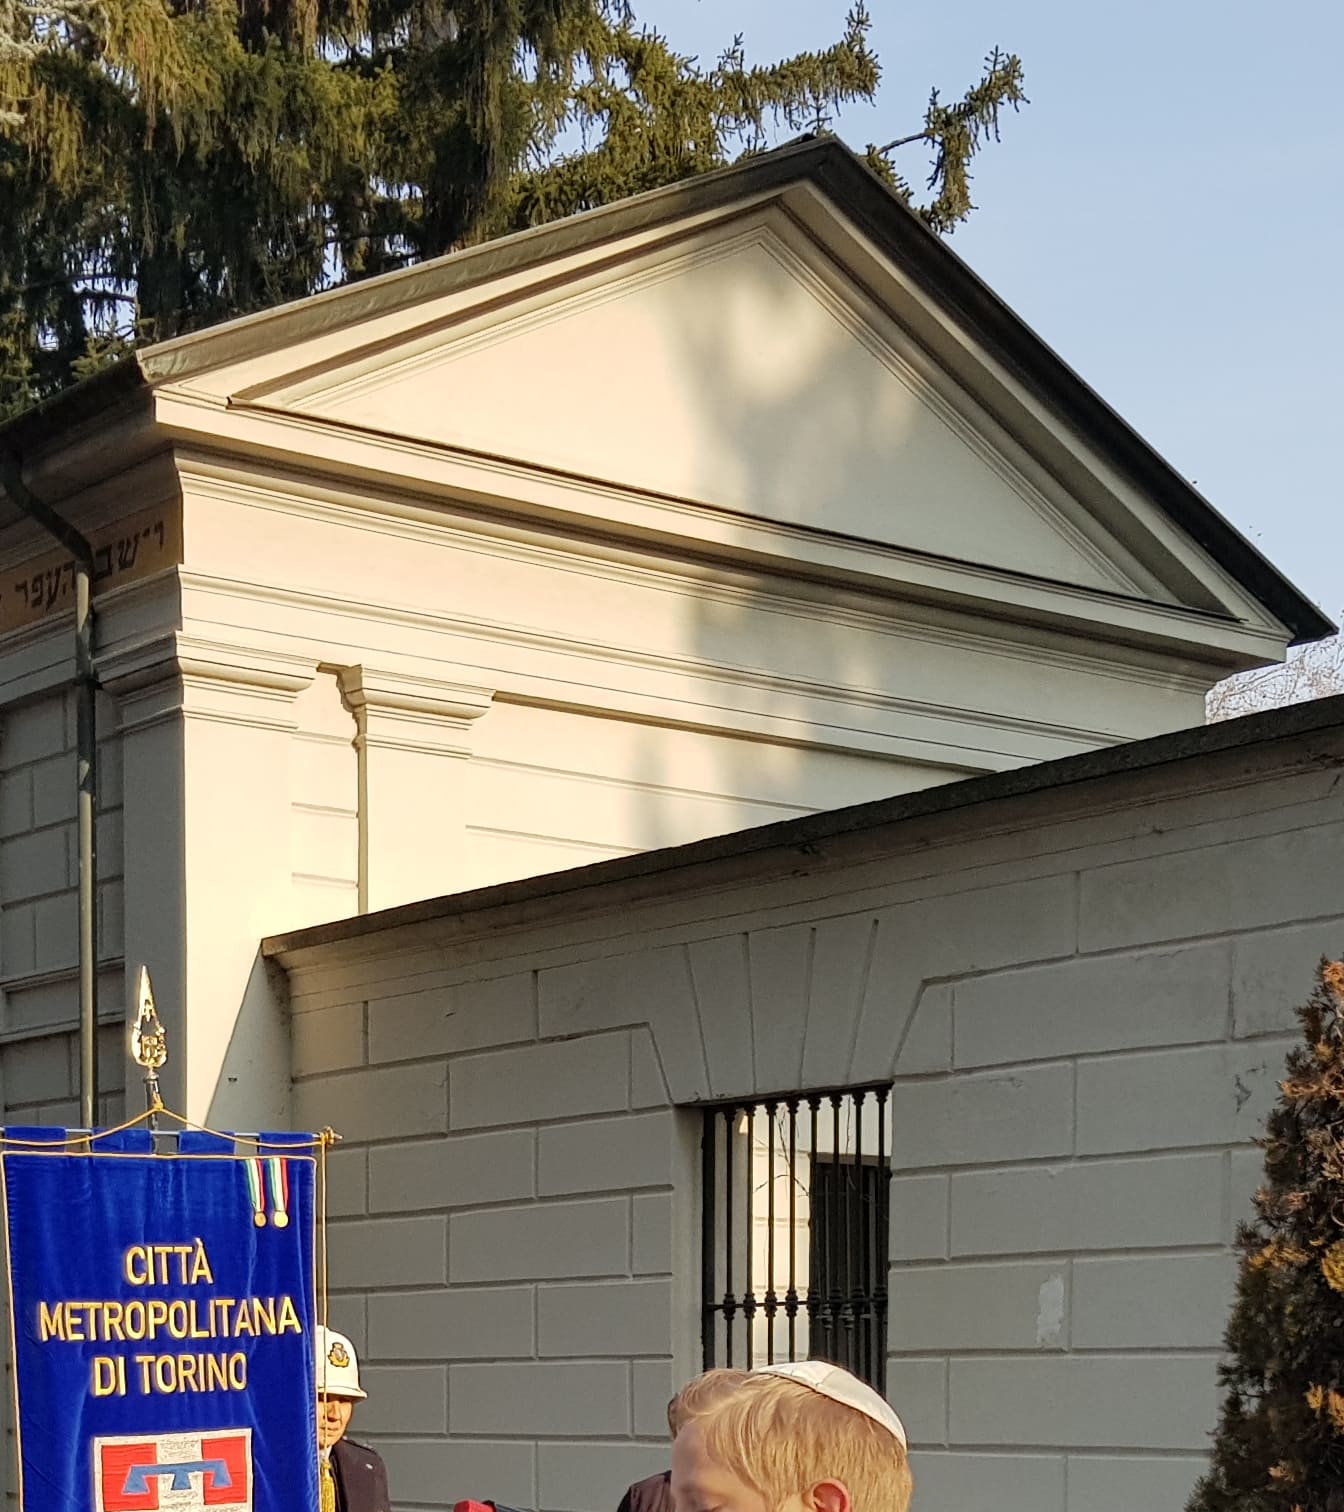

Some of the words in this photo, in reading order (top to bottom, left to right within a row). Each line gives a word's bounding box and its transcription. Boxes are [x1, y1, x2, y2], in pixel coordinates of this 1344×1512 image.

[125, 1237, 214, 1286] CITTÀ
[39, 1296, 303, 1342] METROPOLITANA
[93, 1356, 126, 1396] DI
[135, 1352, 248, 1394] TORINO
